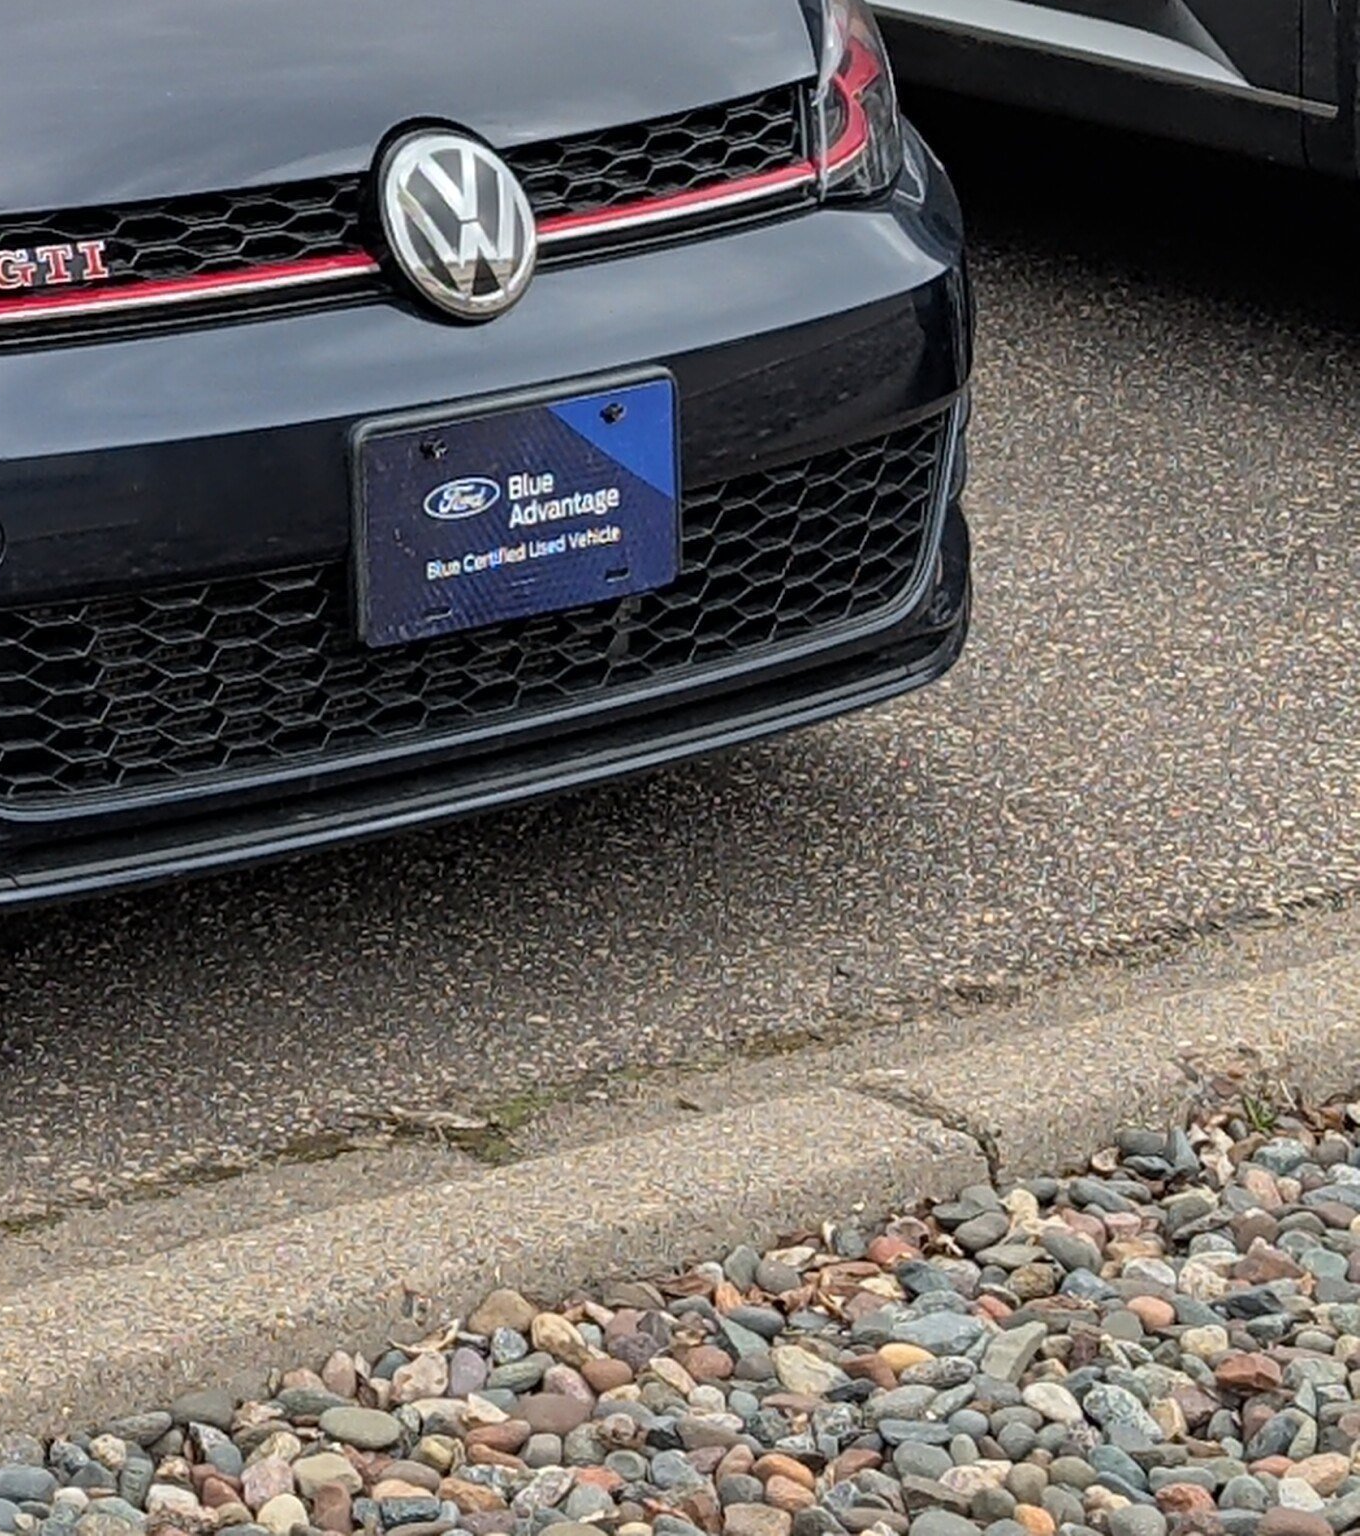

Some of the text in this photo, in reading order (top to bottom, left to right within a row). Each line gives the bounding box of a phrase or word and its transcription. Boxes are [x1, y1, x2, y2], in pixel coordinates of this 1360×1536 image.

[508, 472, 555, 500] Blue
[508, 487, 621, 529] Advantage
[426, 524, 622, 580] Blue Certified Used Vehicle
